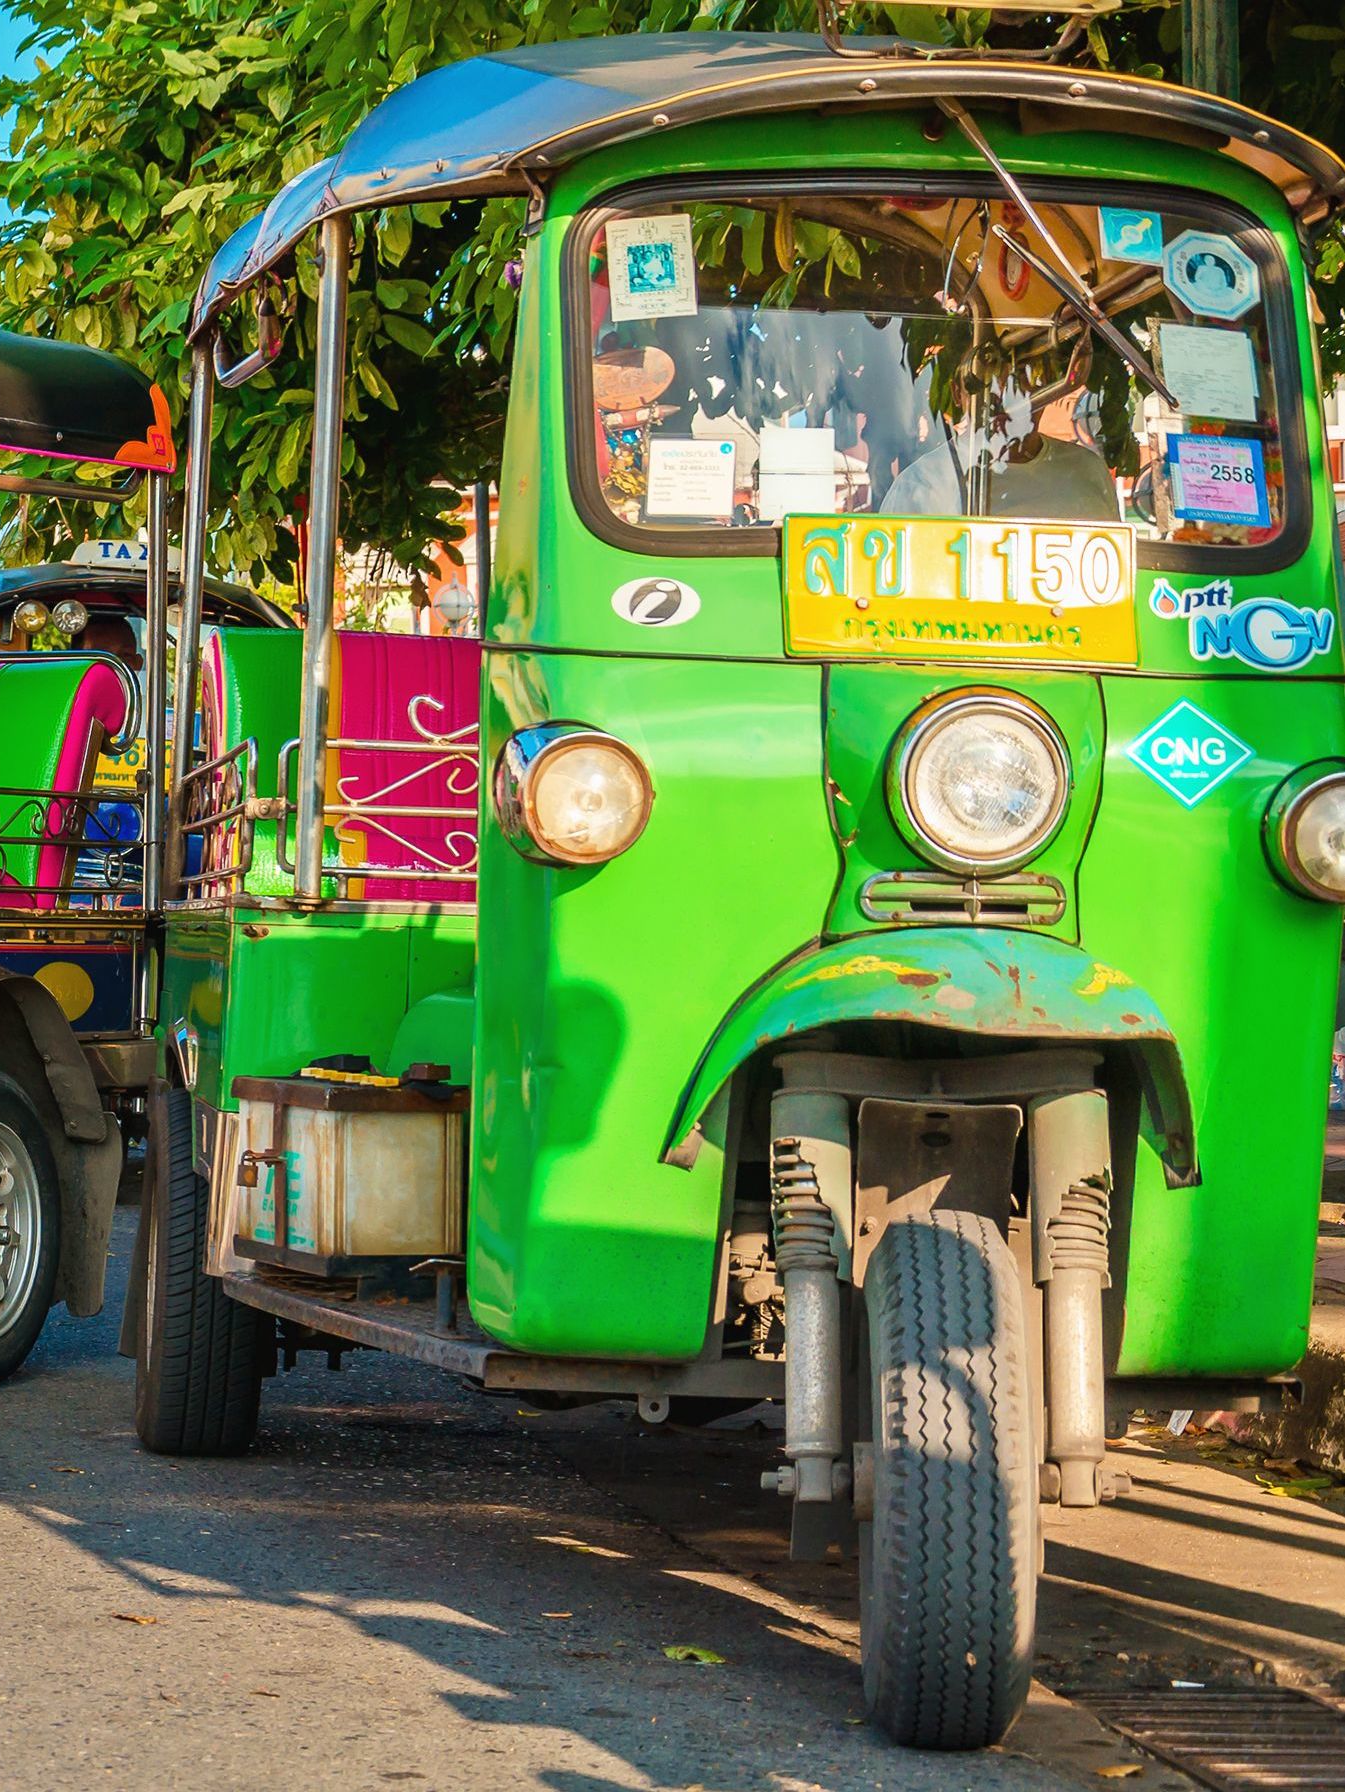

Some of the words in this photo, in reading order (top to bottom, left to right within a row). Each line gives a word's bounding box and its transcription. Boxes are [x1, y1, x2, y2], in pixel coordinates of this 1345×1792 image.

[1210, 464, 1256, 485] 2558
[98, 542, 149, 560] TAX
[803, 522, 906, 597] สข
[946, 529, 1122, 606] 1150
[1183, 585, 1230, 613] ptt
[843, 617, 1084, 652] กรุงเทพมหานคร
[1194, 599, 1333, 668] NGV
[1149, 736, 1227, 766] CNG
